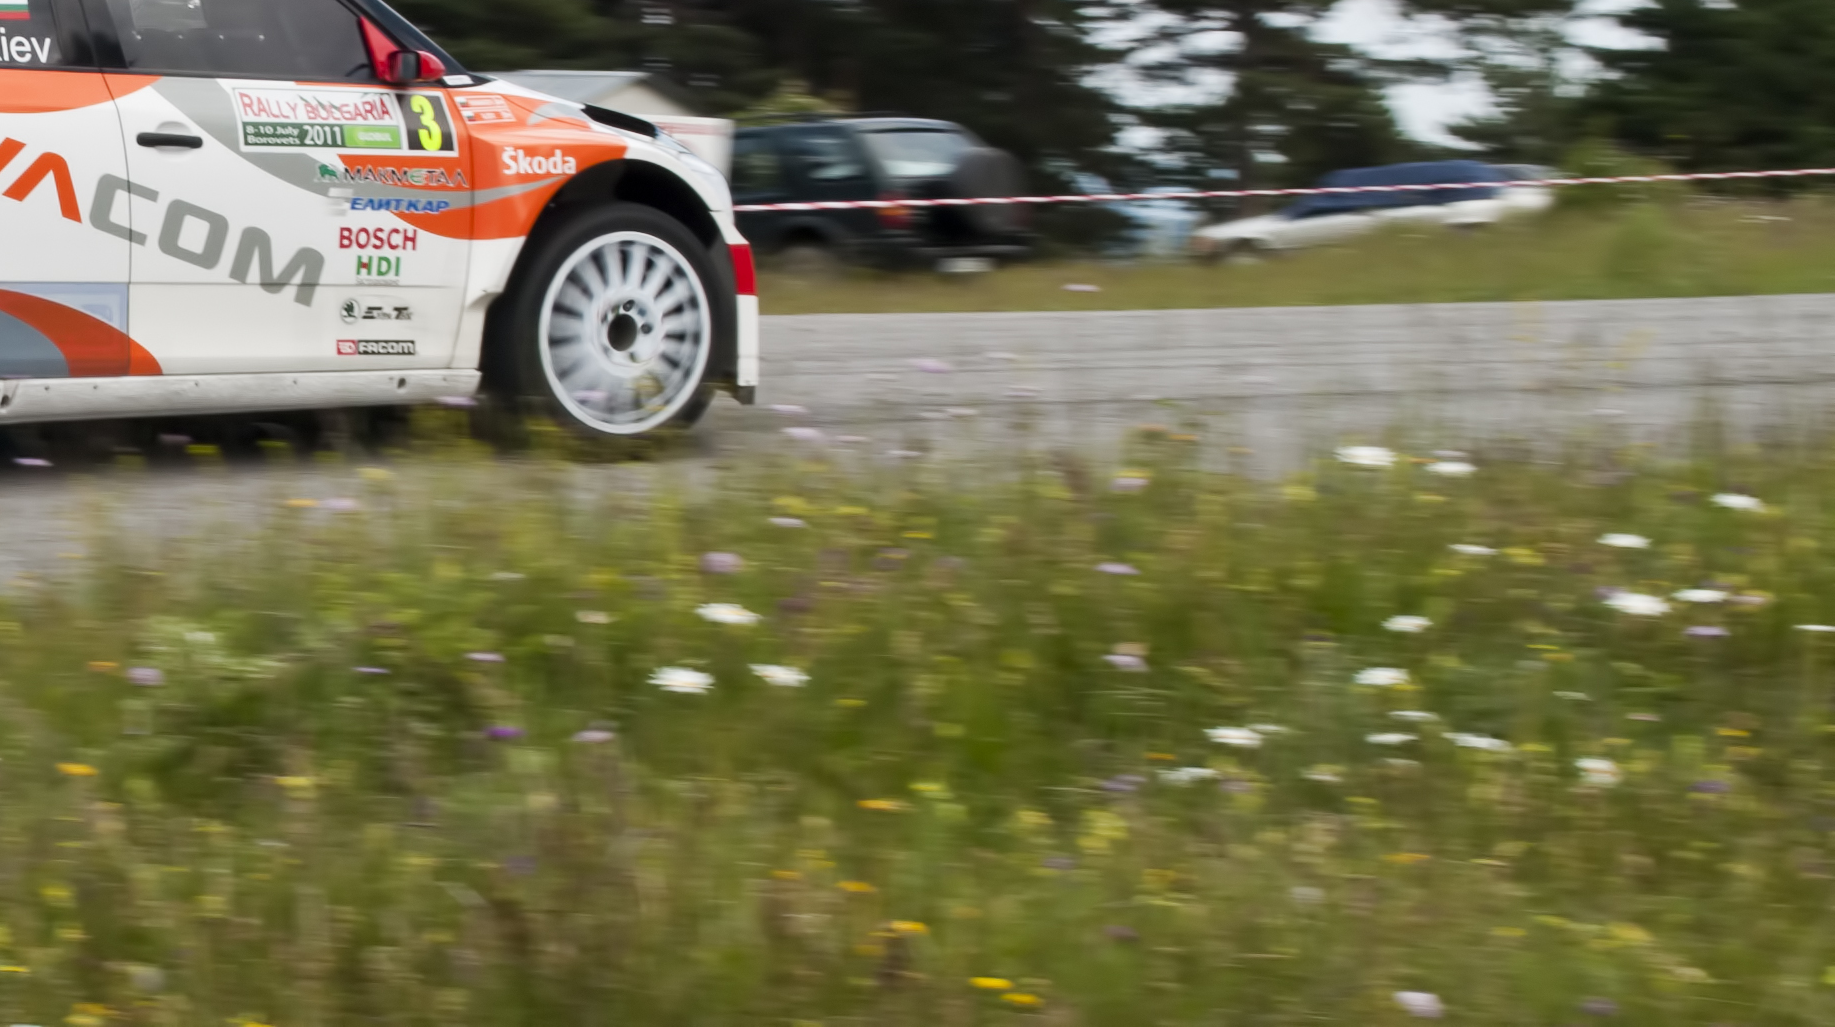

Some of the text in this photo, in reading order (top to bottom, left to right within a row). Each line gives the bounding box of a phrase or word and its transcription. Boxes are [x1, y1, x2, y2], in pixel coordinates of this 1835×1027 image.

[238, 92, 393, 121] RALLY BULGARIA
[410, 94, 443, 152] 3
[303, 125, 343, 145] 2011
[501, 146, 577, 175] Škoda
[339, 227, 418, 250] BOSCH
[356, 255, 401, 277] HDI
[358, 341, 414, 354] FACOM
